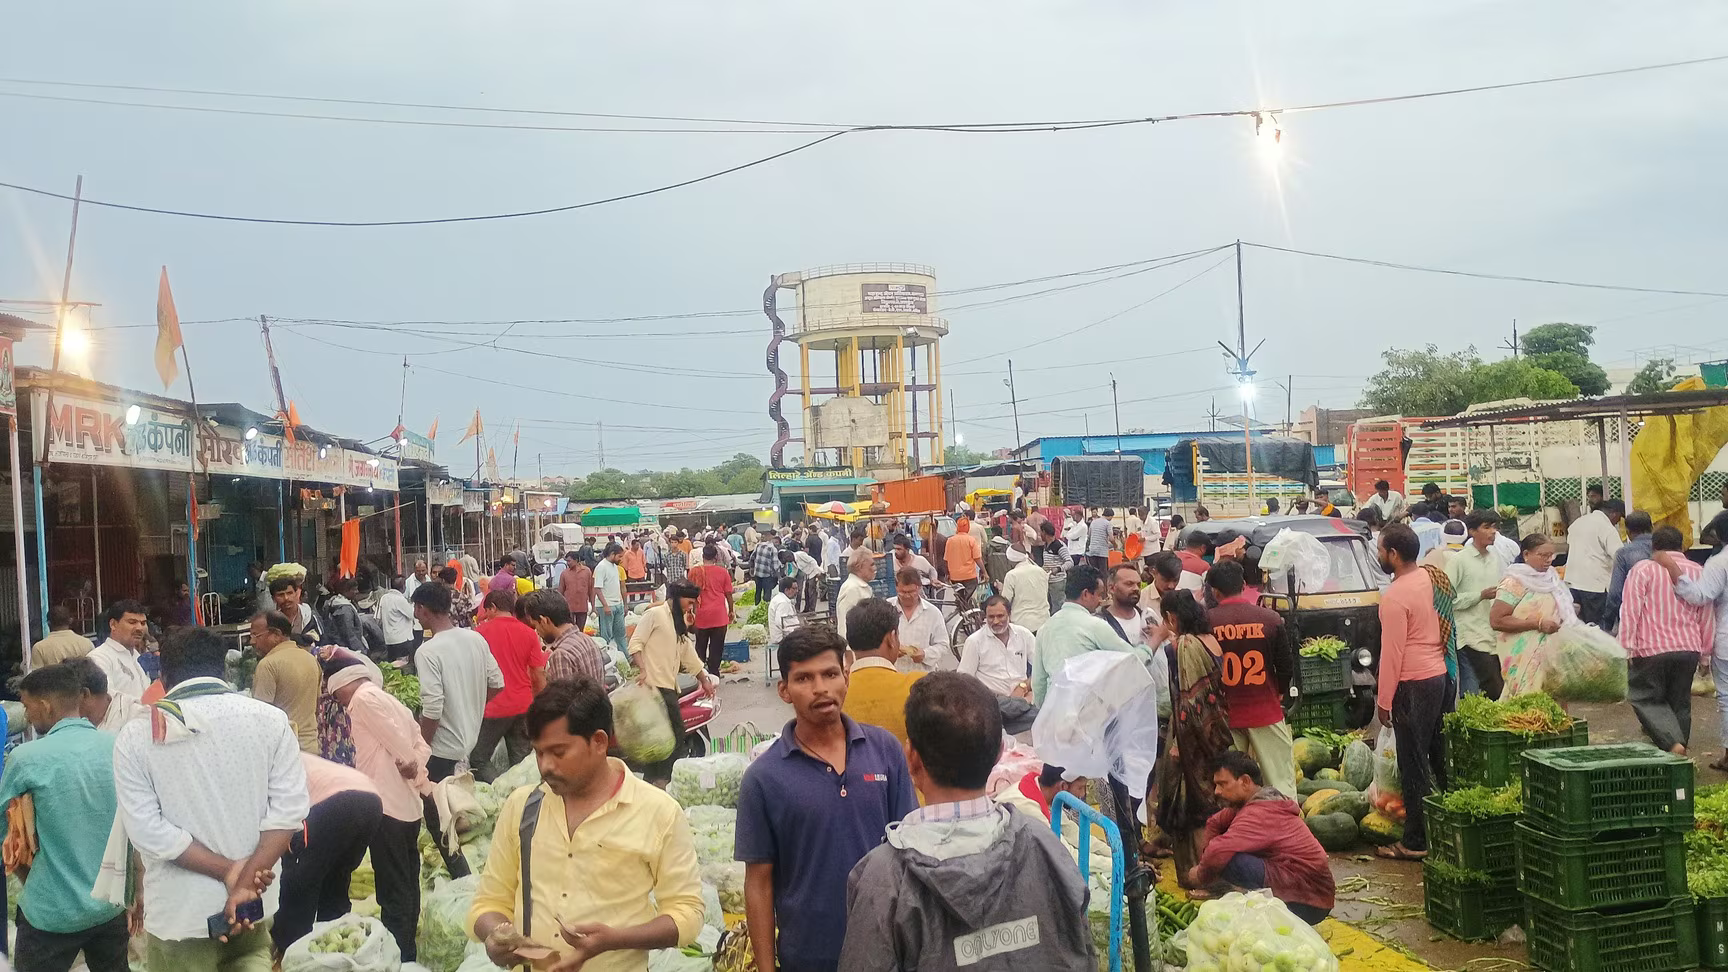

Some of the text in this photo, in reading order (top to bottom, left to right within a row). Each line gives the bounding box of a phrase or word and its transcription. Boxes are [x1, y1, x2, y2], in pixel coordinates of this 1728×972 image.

[50, 404, 130, 455] MRK
[148, 412, 191, 456] कंपनी
[257, 438, 282, 467] कंपनी
[826, 468, 852, 478] कंपनी
[1213, 623, 1265, 641] TOFIK
[1221, 650, 1266, 687] 02
[1716, 921, 1724, 932] M
[1718, 943, 1725, 954] S
